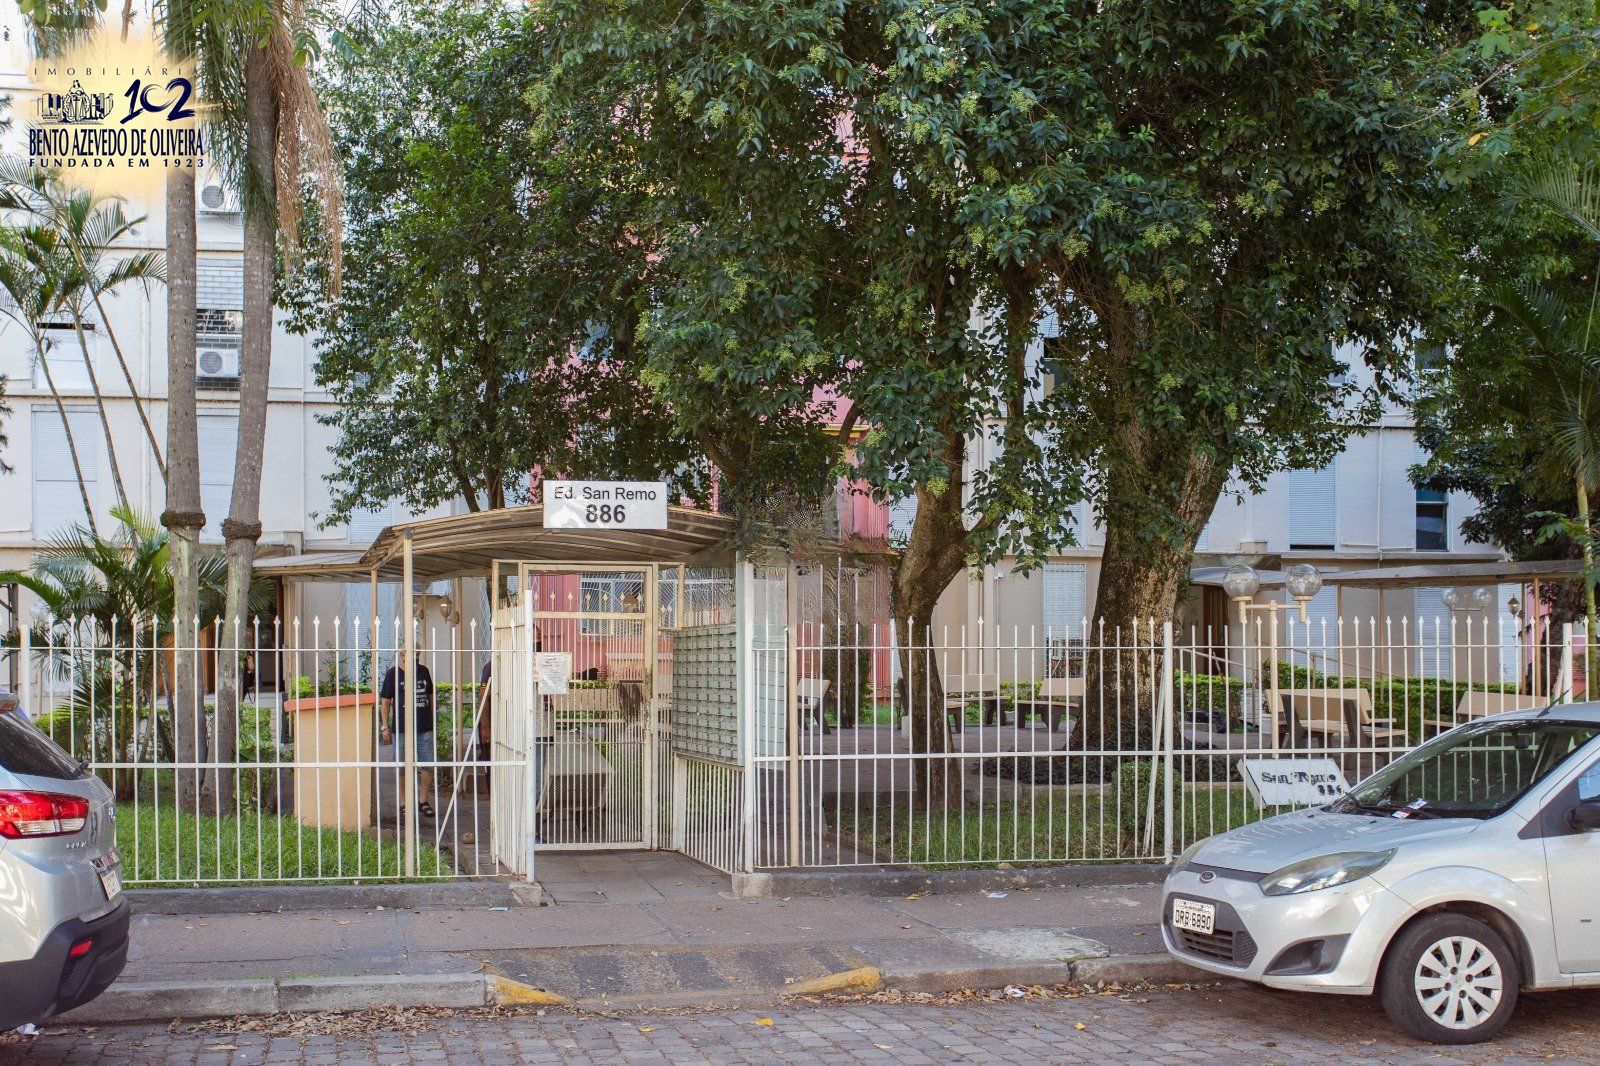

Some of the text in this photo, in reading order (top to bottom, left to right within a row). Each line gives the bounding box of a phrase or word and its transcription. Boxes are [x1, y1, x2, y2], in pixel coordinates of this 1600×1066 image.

[583, 486, 610, 500] San
[615, 487, 657, 501] Remo
[585, 503, 626, 524] 886
